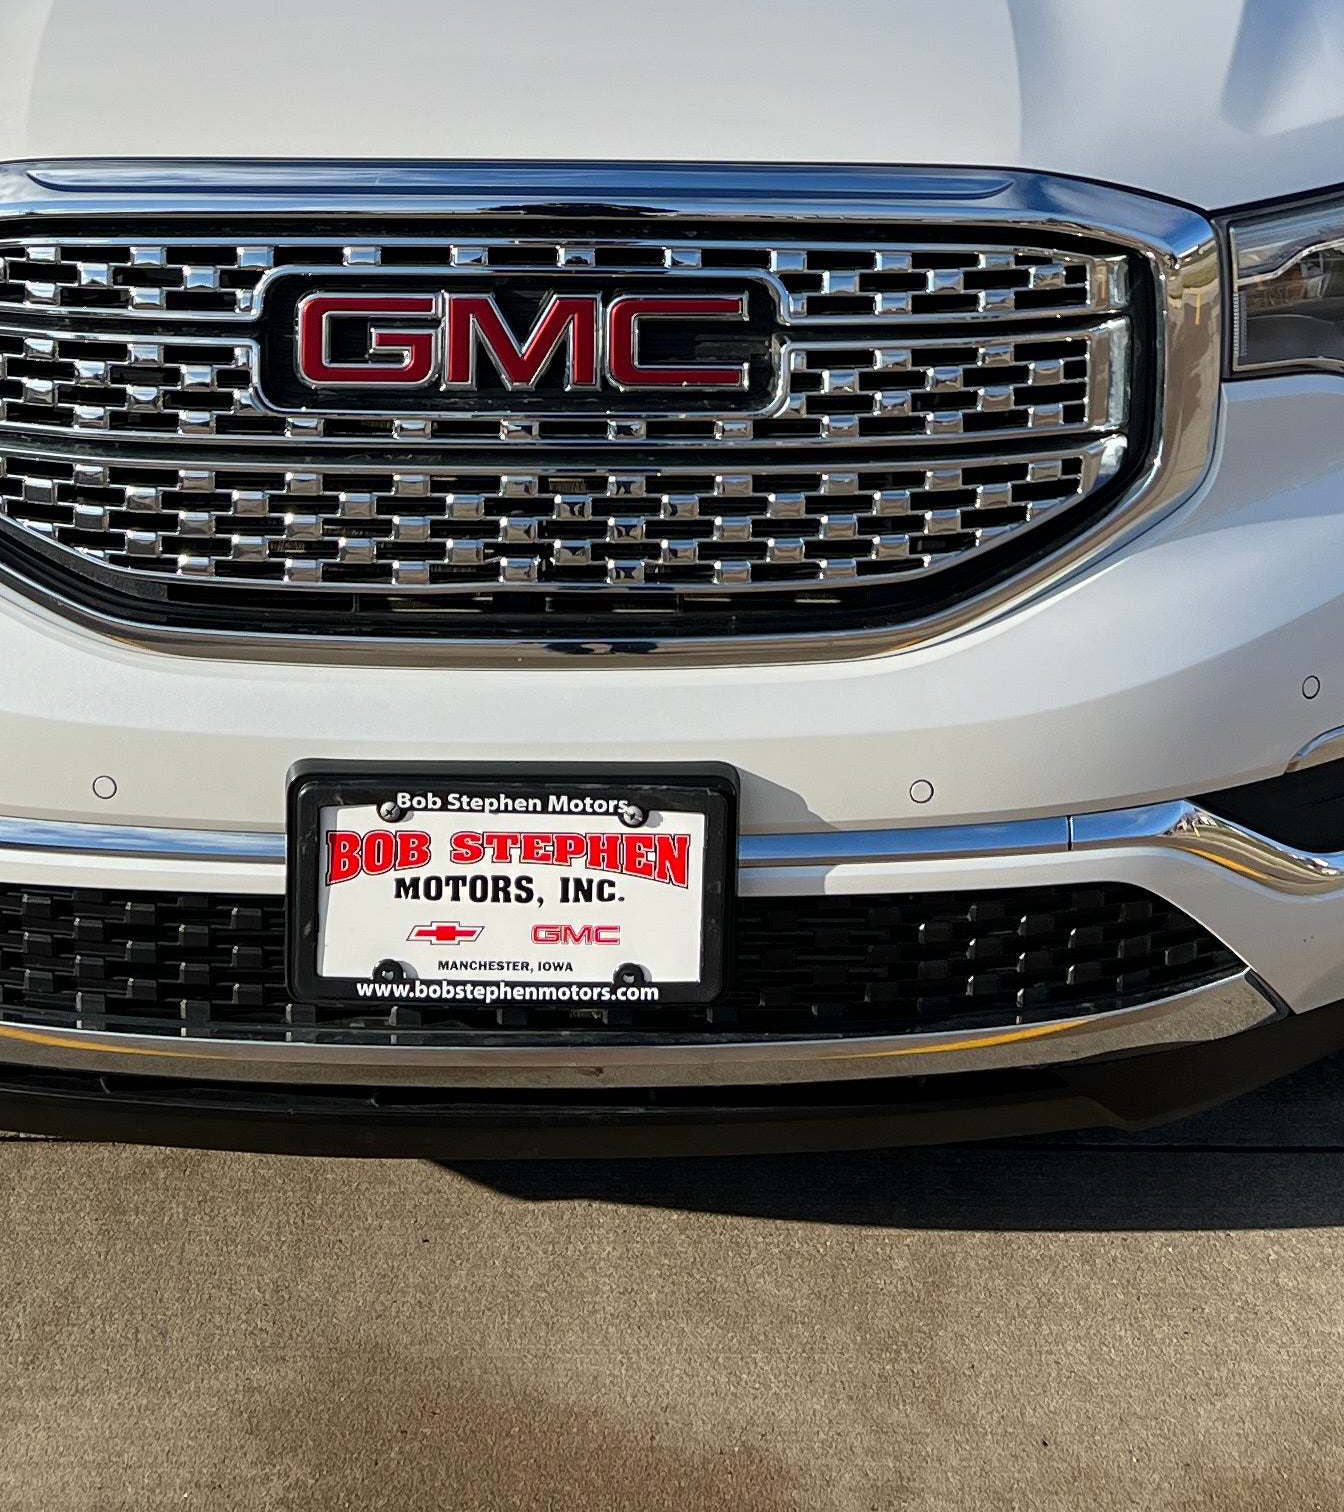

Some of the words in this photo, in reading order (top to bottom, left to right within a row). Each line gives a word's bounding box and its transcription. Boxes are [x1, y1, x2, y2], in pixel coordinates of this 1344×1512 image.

[296, 290, 749, 391] GMC
[396, 792, 442, 810] Bob
[447, 793, 542, 813] Stephen
[548, 795, 629, 813] Motors
[326, 829, 431, 886] BOB
[450, 831, 691, 889] STEPHEN
[394, 874, 544, 908] MOTORS,
[559, 876, 625, 903] INC.
[531, 924, 621, 946] GMC
[438, 960, 534, 974] MANCHESTER,
[538, 961, 573, 973] IOWA
[356, 980, 659, 1004] www.bobstephenmotors.com
